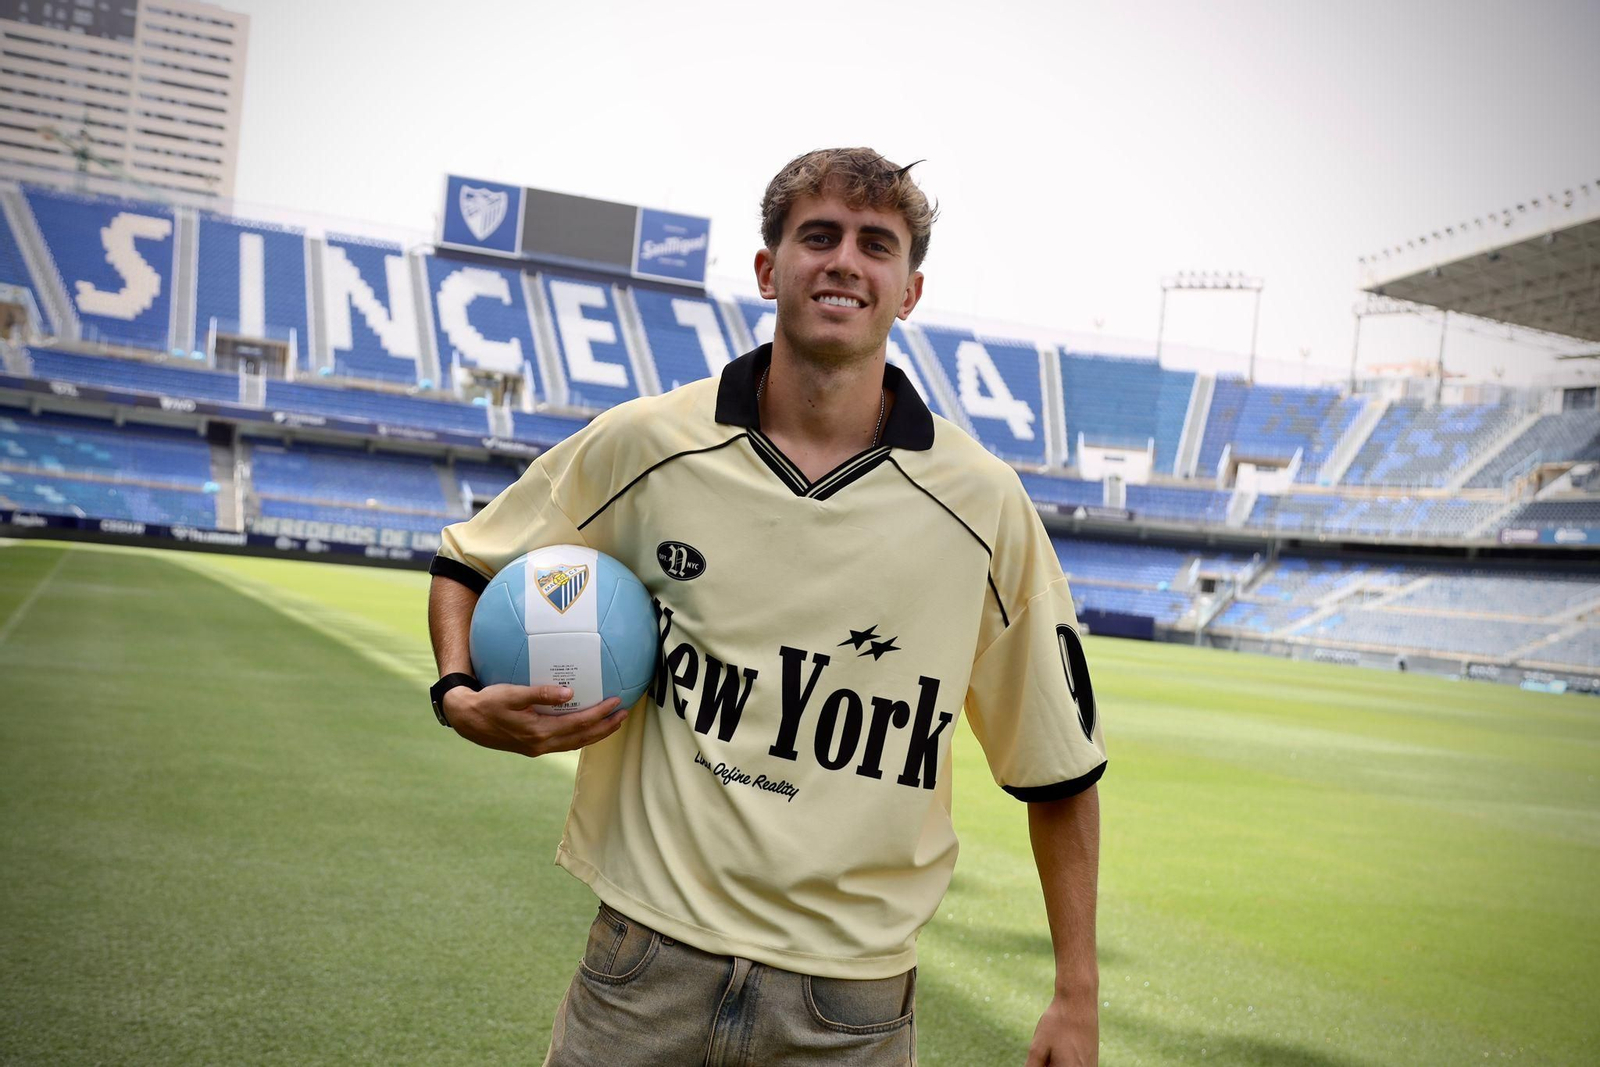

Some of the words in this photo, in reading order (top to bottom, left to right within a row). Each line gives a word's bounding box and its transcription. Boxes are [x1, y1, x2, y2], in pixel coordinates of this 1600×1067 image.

[75, 211, 628, 388] SINCE
[671, 298, 1035, 441] 14
[686, 561, 699, 570] NYC
[768, 645, 953, 790] York
[751, 774, 800, 803] Reality
